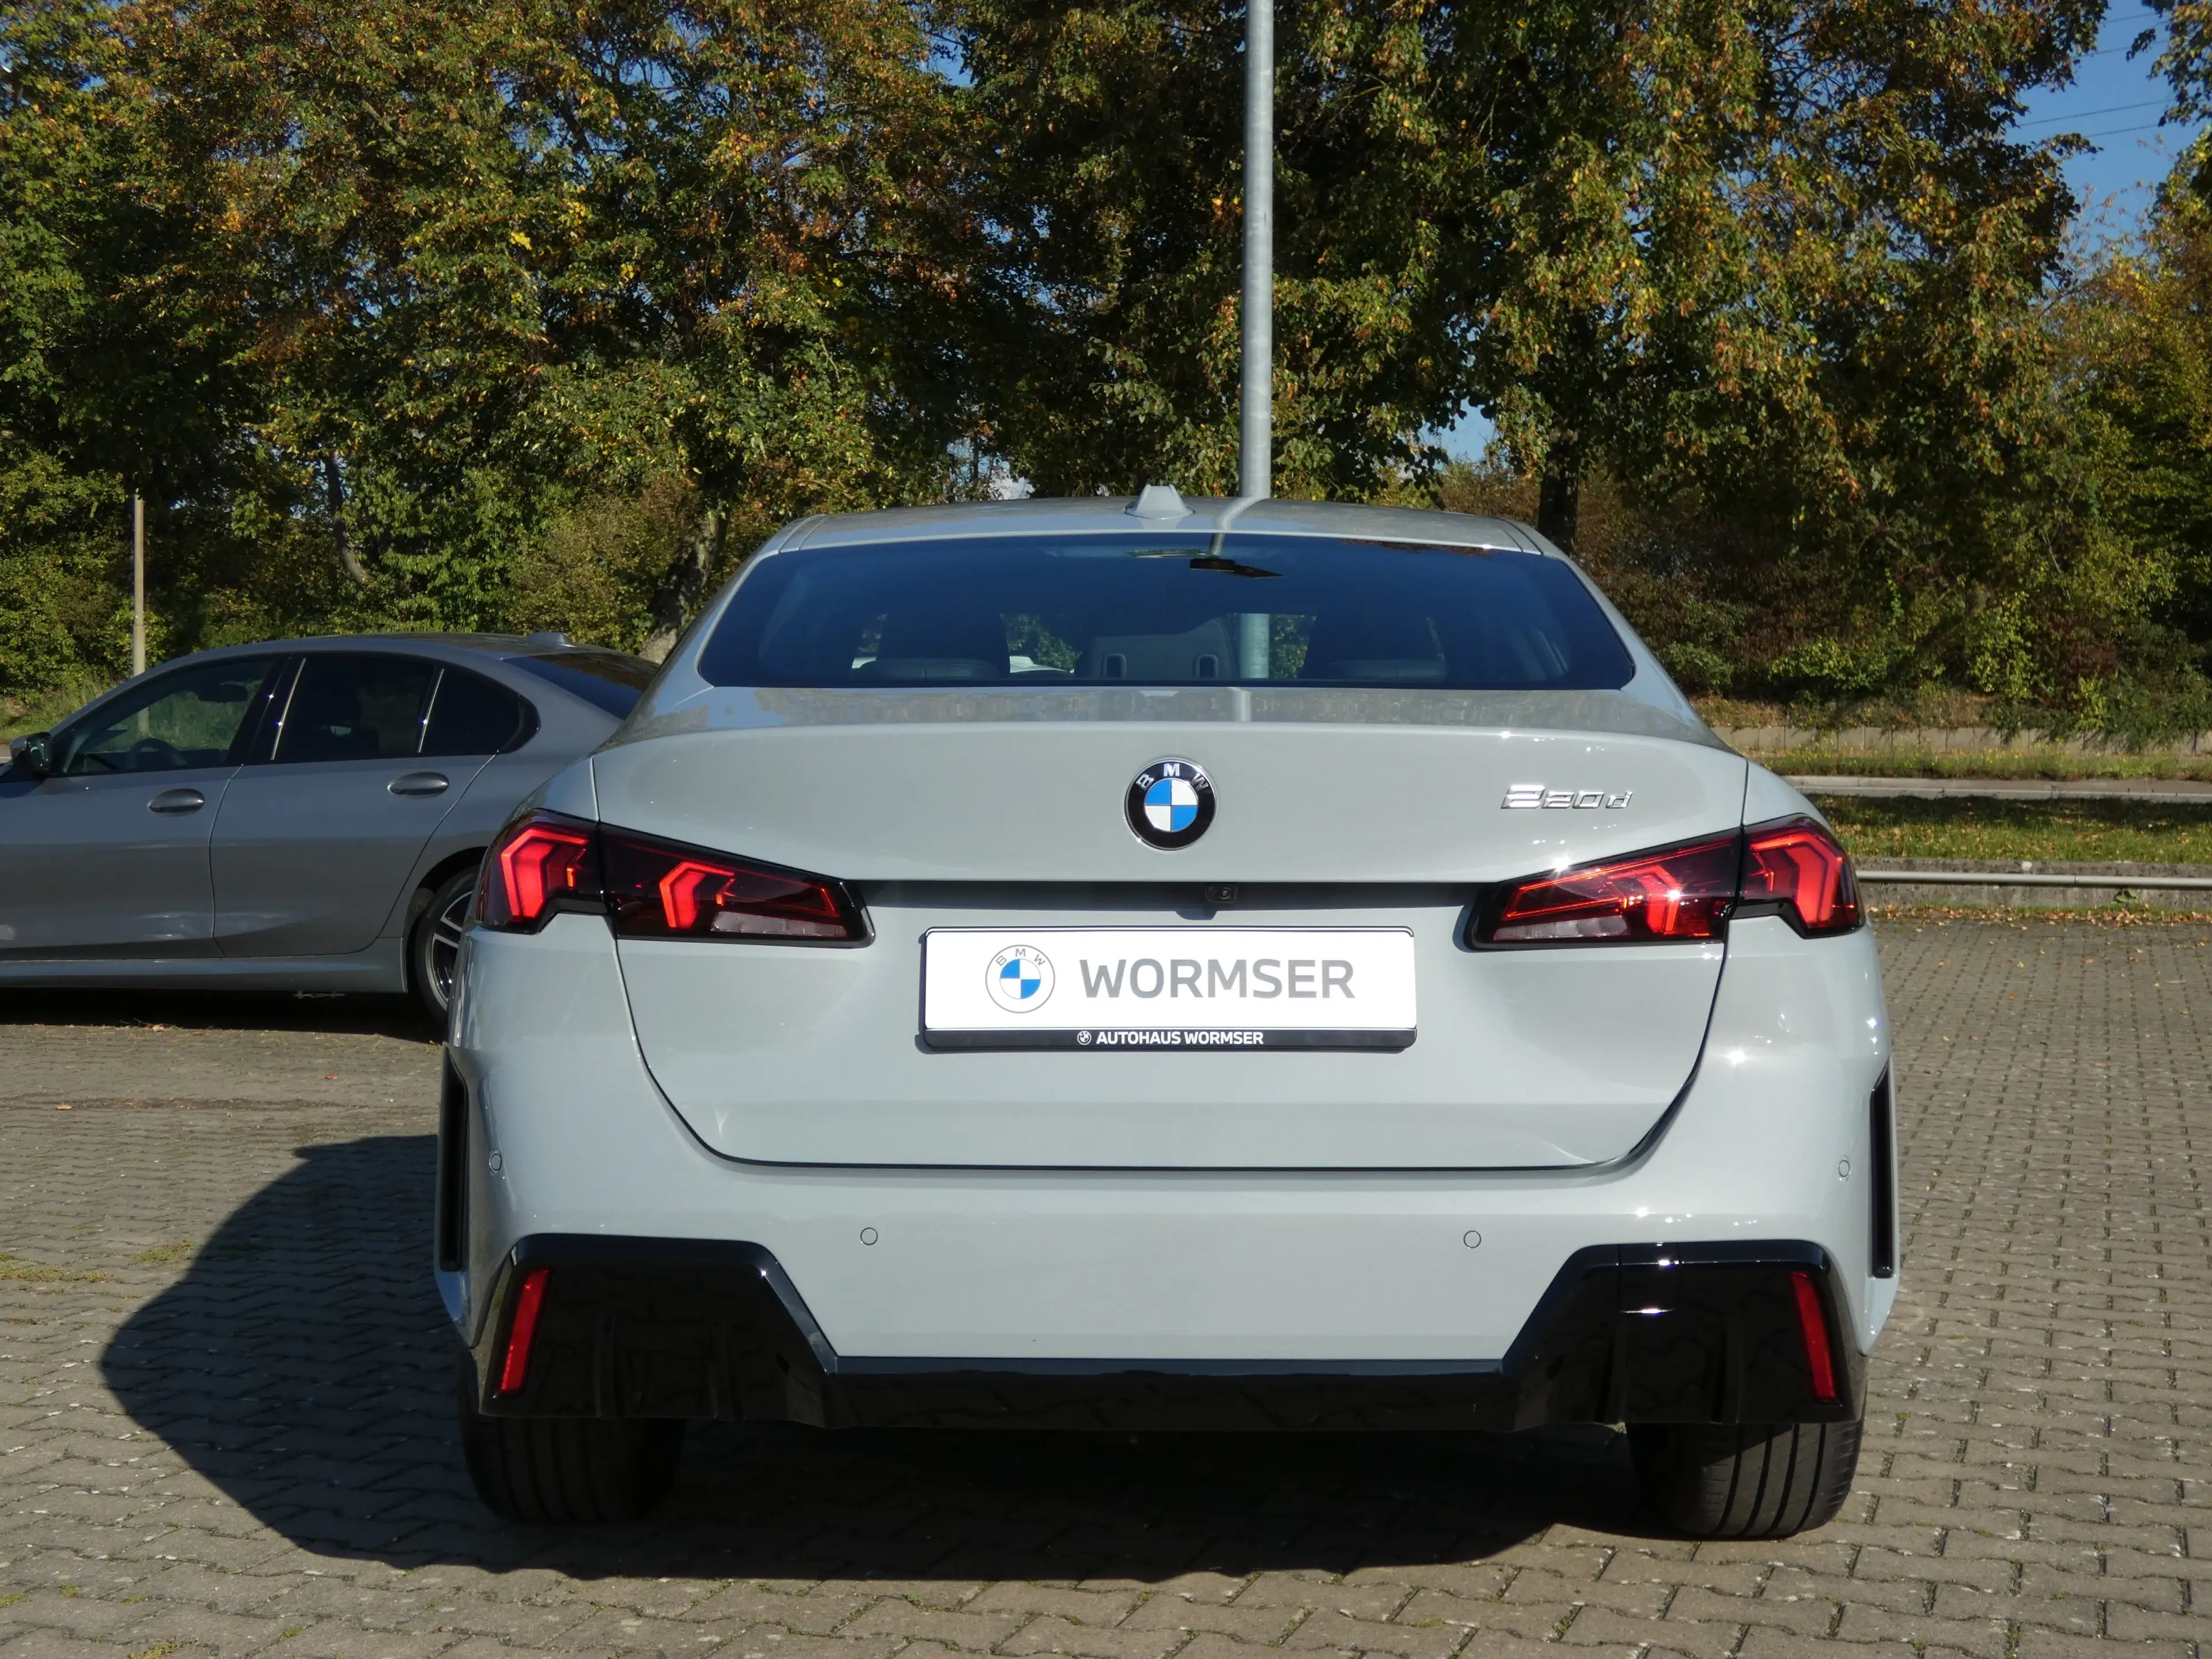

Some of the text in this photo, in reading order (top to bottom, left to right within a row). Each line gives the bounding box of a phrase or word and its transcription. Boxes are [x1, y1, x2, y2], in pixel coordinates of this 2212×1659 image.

[1136, 763, 1209, 791] BMW
[1501, 785, 1633, 809] 220d
[995, 948, 1046, 967] BMW
[1080, 959, 1355, 999] WORMSER
[1096, 1031, 1264, 1045] AUTOHAUS WORMSER
